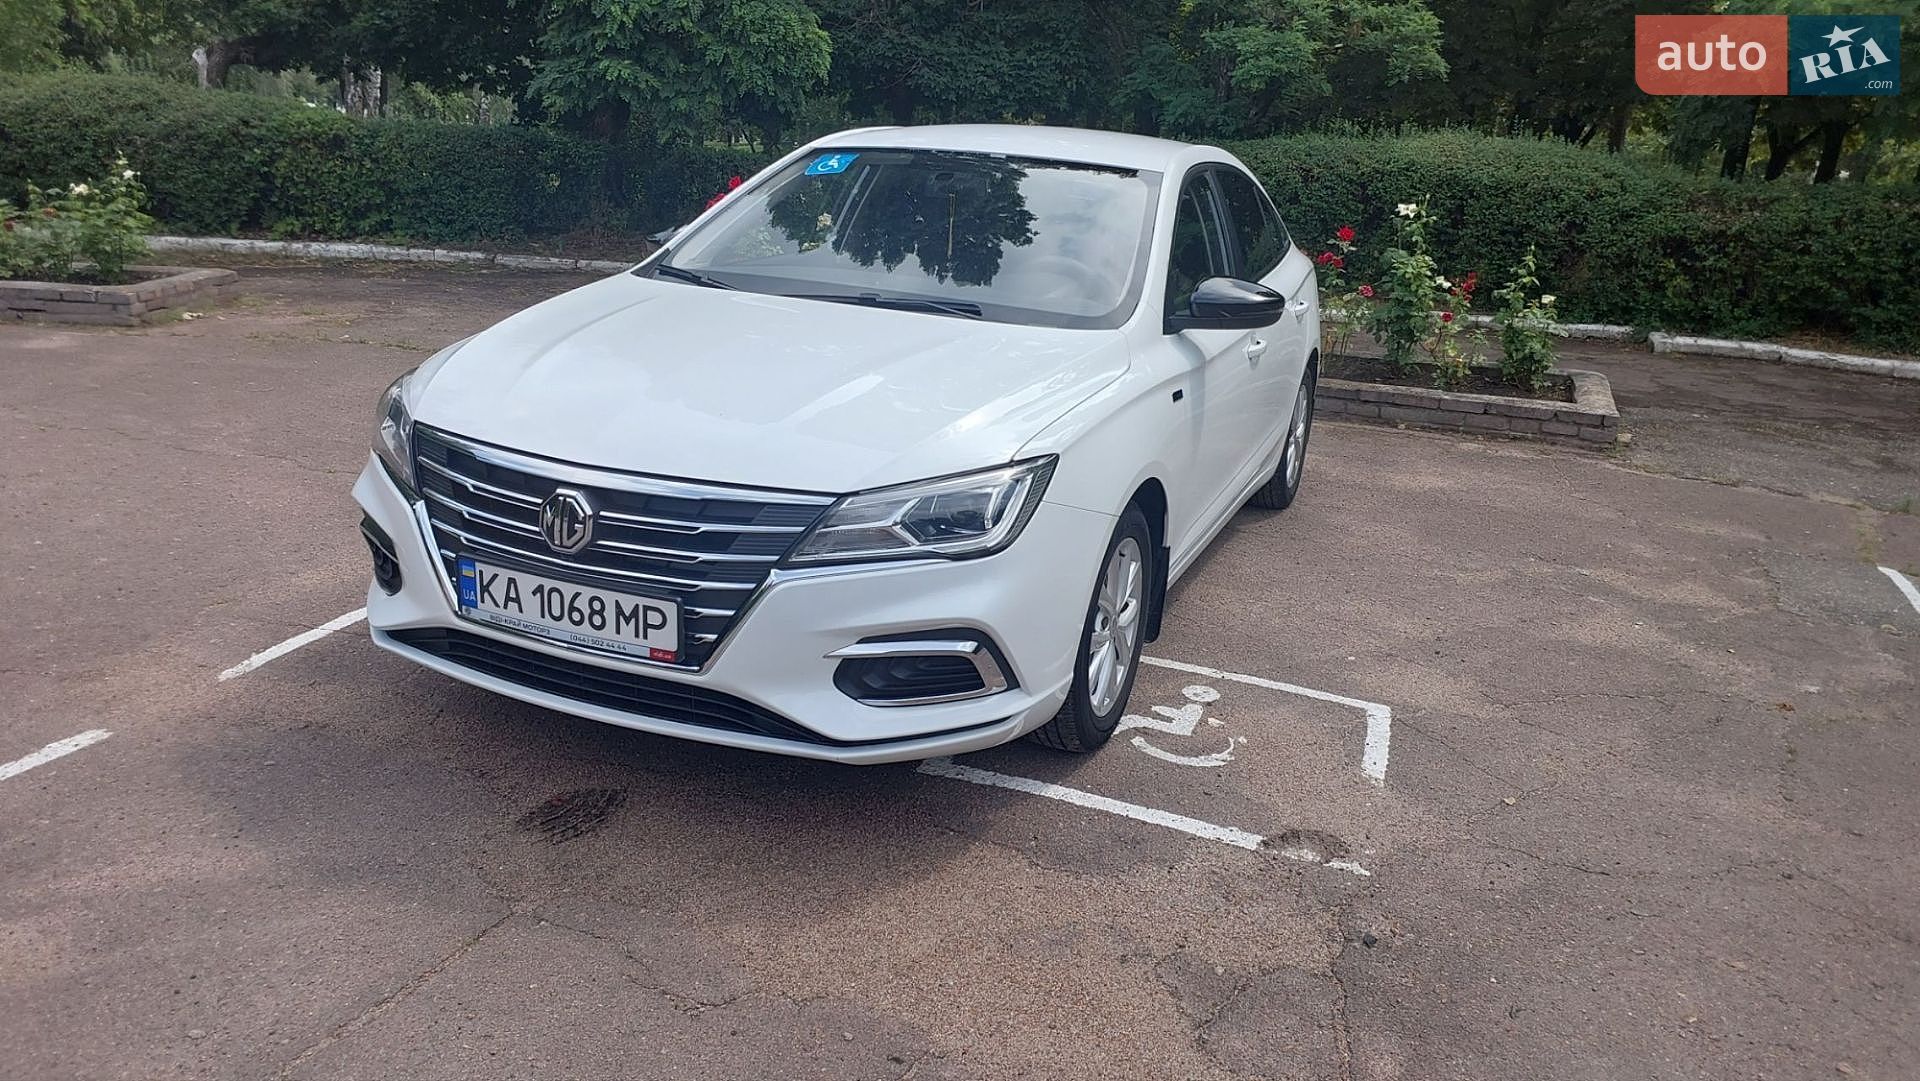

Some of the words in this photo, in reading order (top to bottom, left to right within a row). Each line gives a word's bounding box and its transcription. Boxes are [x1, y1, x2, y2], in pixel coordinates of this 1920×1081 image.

[543, 496, 584, 547] MG
[463, 589, 476, 600] UA
[478, 569, 524, 614] KA
[531, 583, 607, 631] 1068
[615, 599, 667, 640] MP
